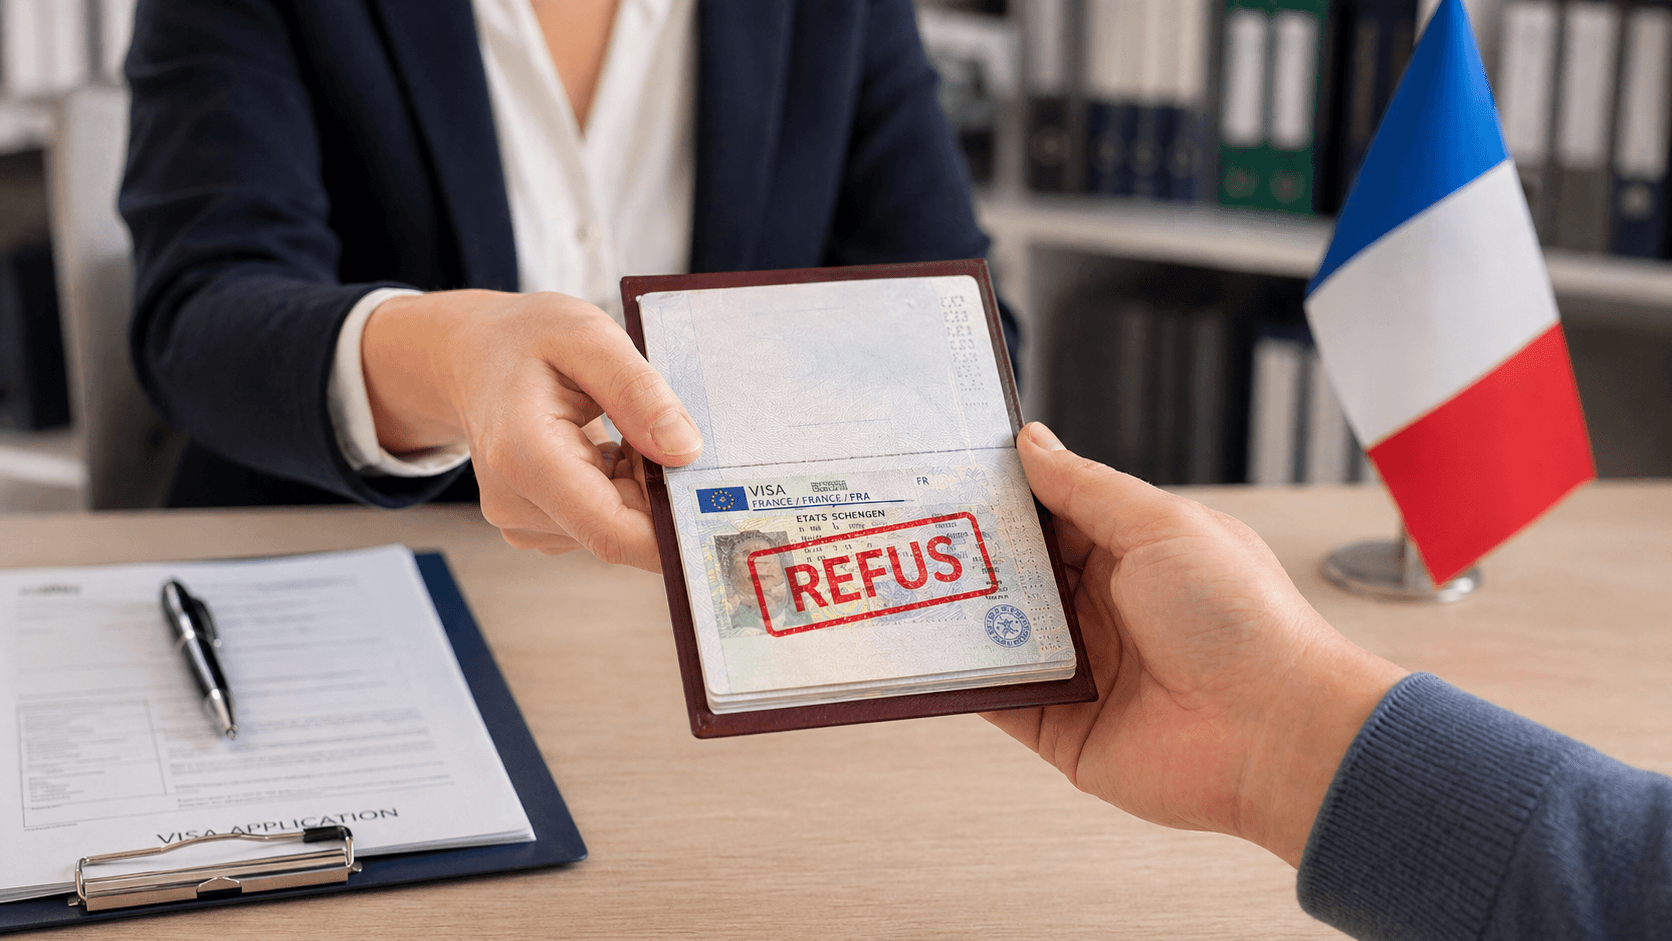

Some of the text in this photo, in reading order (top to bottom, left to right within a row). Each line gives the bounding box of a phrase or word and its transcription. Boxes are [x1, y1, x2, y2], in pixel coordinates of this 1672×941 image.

[916, 476, 930, 485] FR
[748, 484, 786, 497] VISA
[752, 498, 793, 508] FRANCE
[802, 494, 841, 504] FRANCE
[849, 492, 871, 501] FRA
[796, 509, 886, 523] ETATS SCHENGEN
[784, 535, 964, 613] REFUS
[157, 808, 399, 844] VISA APPLICATION
